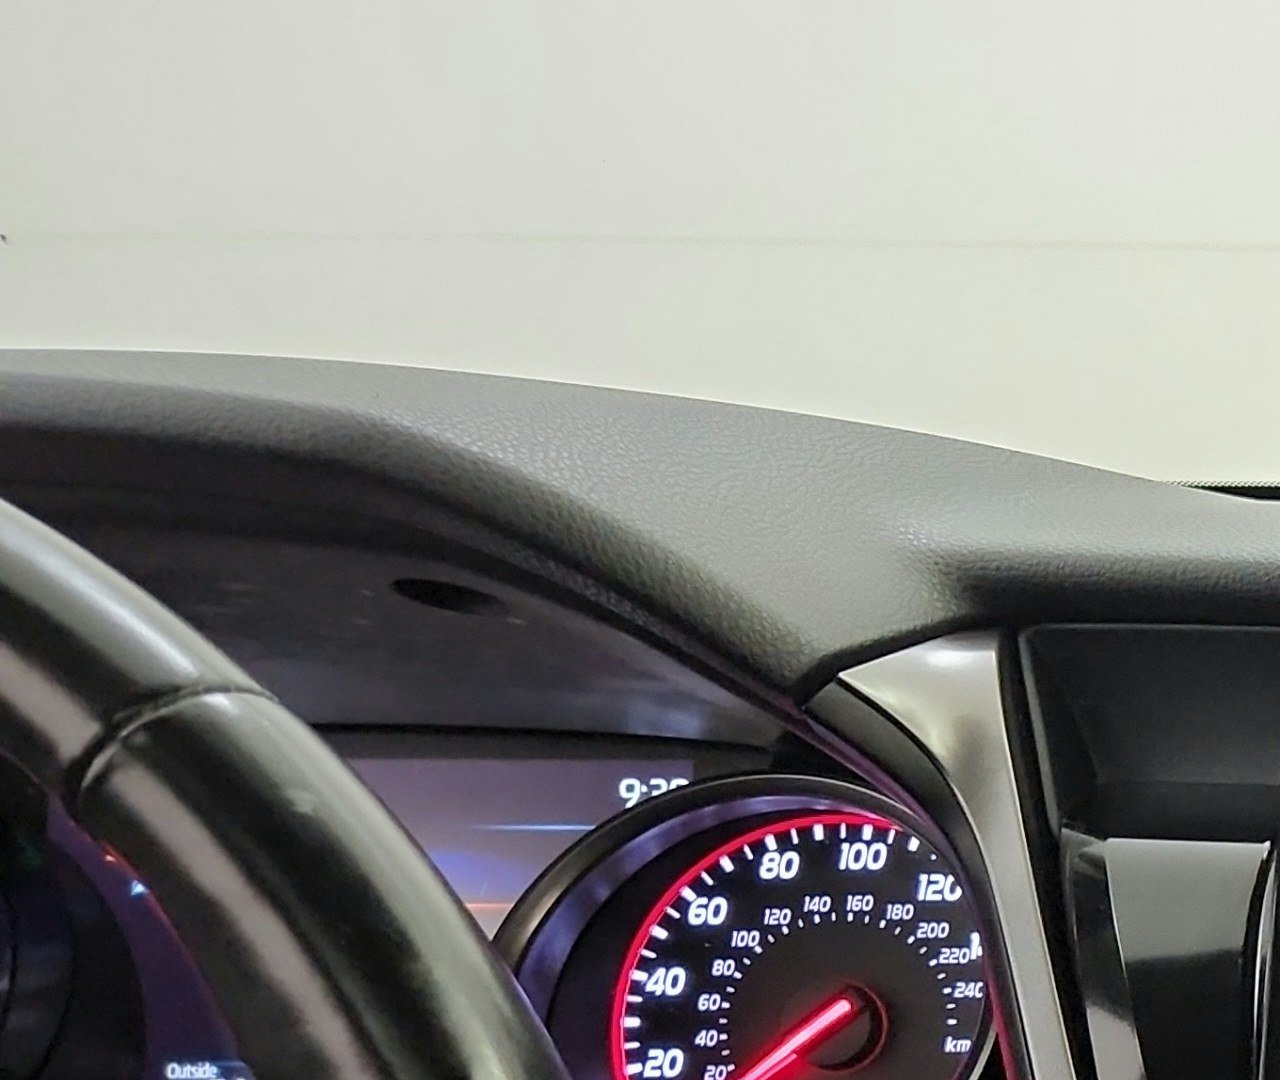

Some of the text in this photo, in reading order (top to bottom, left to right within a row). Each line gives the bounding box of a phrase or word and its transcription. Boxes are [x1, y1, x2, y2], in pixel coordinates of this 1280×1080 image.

[617, 776, 690, 809] 9:3
[758, 848, 800, 880] 80
[838, 841, 888, 871] 100
[686, 897, 729, 926] 60
[803, 895, 832, 913] 140
[846, 894, 874, 912] 160
[885, 903, 915, 921] 180
[763, 908, 792, 926] 120
[730, 930, 760, 948] 100
[916, 921, 950, 939] 200
[938, 947, 971, 964] 220
[711, 958, 735, 977] 80
[644, 966, 687, 996] 40
[697, 993, 721, 1012] 60
[694, 1029, 719, 1047] 40
[943, 1035, 972, 1053] km
[165, 1061, 219, 1080] Outside
[643, 1048, 685, 1078] 20
